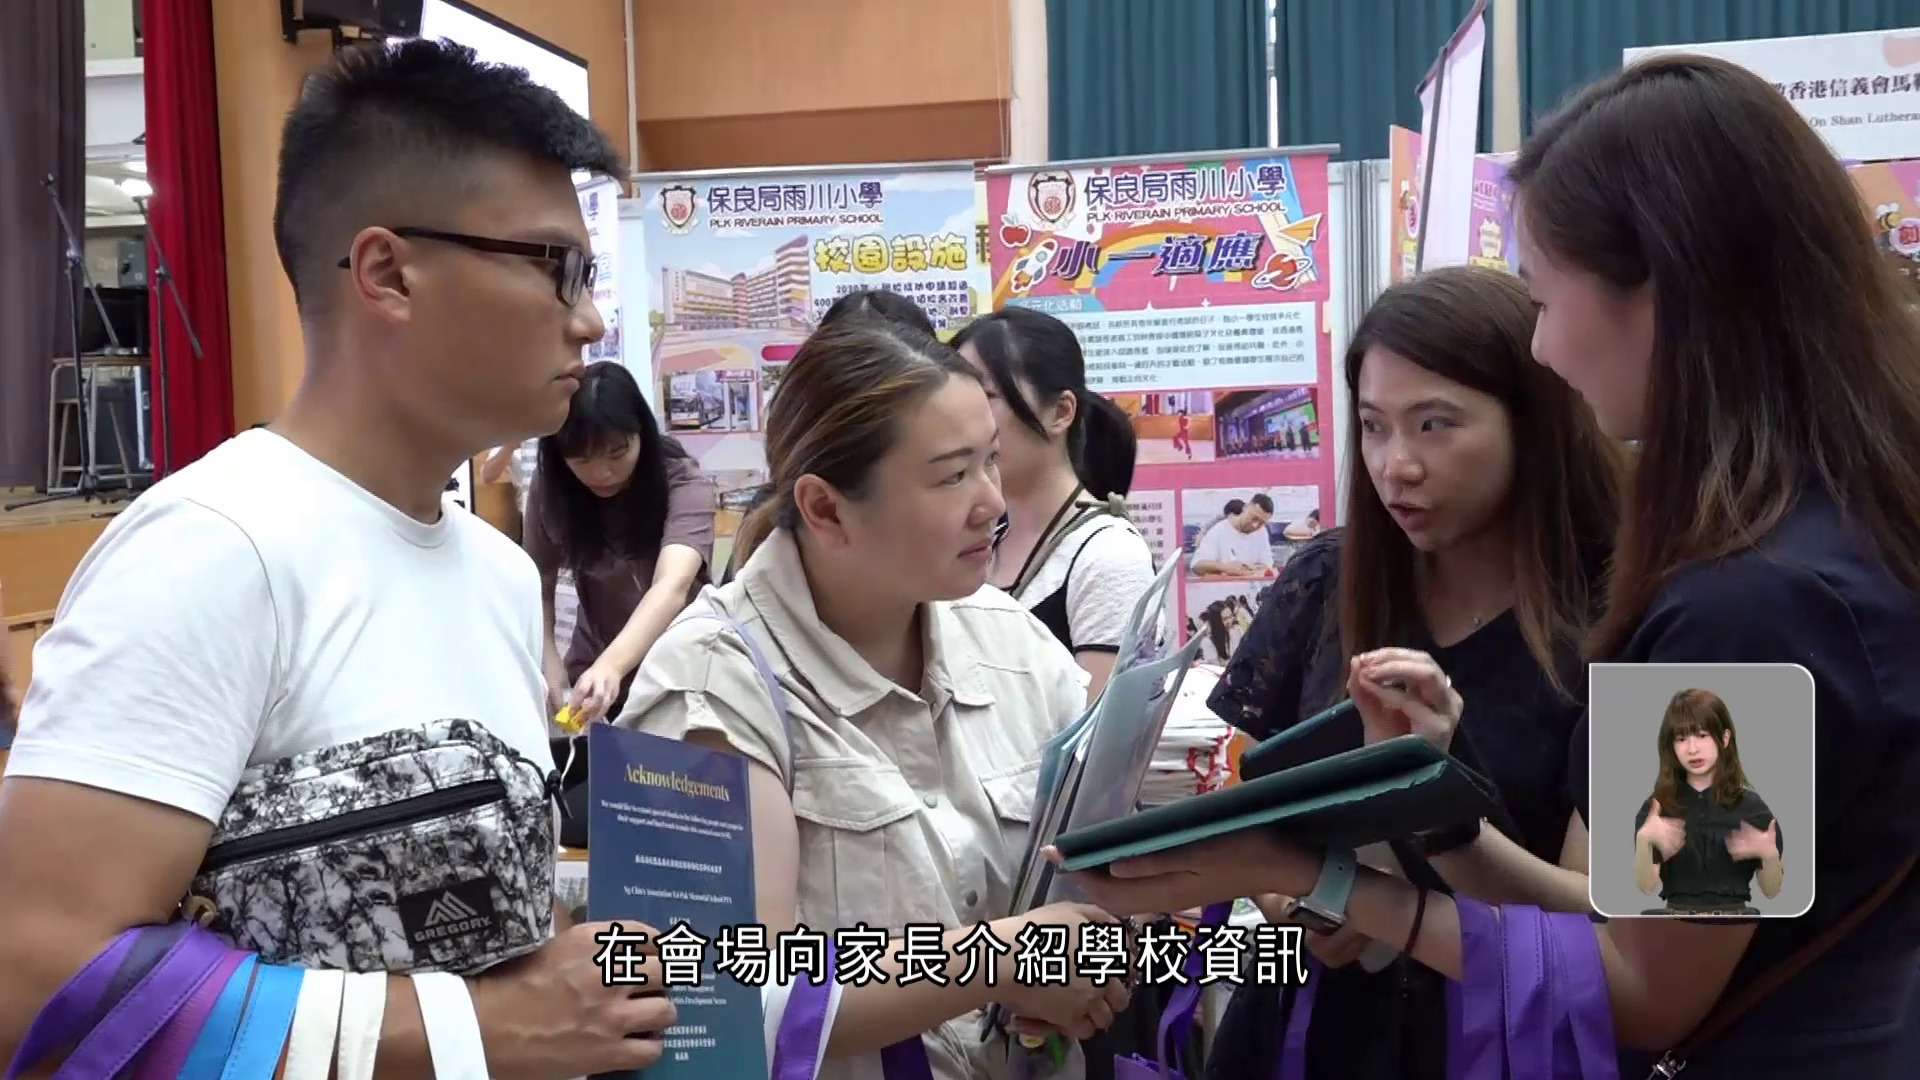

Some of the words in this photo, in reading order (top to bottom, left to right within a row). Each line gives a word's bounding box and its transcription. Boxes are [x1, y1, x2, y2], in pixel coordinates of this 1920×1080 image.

[1775, 73, 1920, 100] 香港信義會馬
[1809, 115, 1827, 128] On
[1831, 113, 1863, 127] Shan
[1867, 112, 1920, 124] Luthera
[707, 181, 883, 214] 保良局雨川小學
[1084, 164, 1285, 206] 保良局雨川小學
[709, 217, 732, 229] PLK
[734, 215, 785, 228] RIVERAIN
[787, 214, 835, 226] PRIMARY
[838, 212, 884, 224] SCHOOL
[1086, 211, 1112, 223] PLK
[1115, 207, 1171, 222] RIVERAIN
[1174, 205, 1230, 218] PRIMARY
[1234, 201, 1286, 214] SCHOOL
[813, 232, 968, 274] 校園設施
[1051, 231, 1265, 280] 小一適應
[624, 762, 731, 803] Acknowledgements
[414, 916, 492, 942] GREGORY
